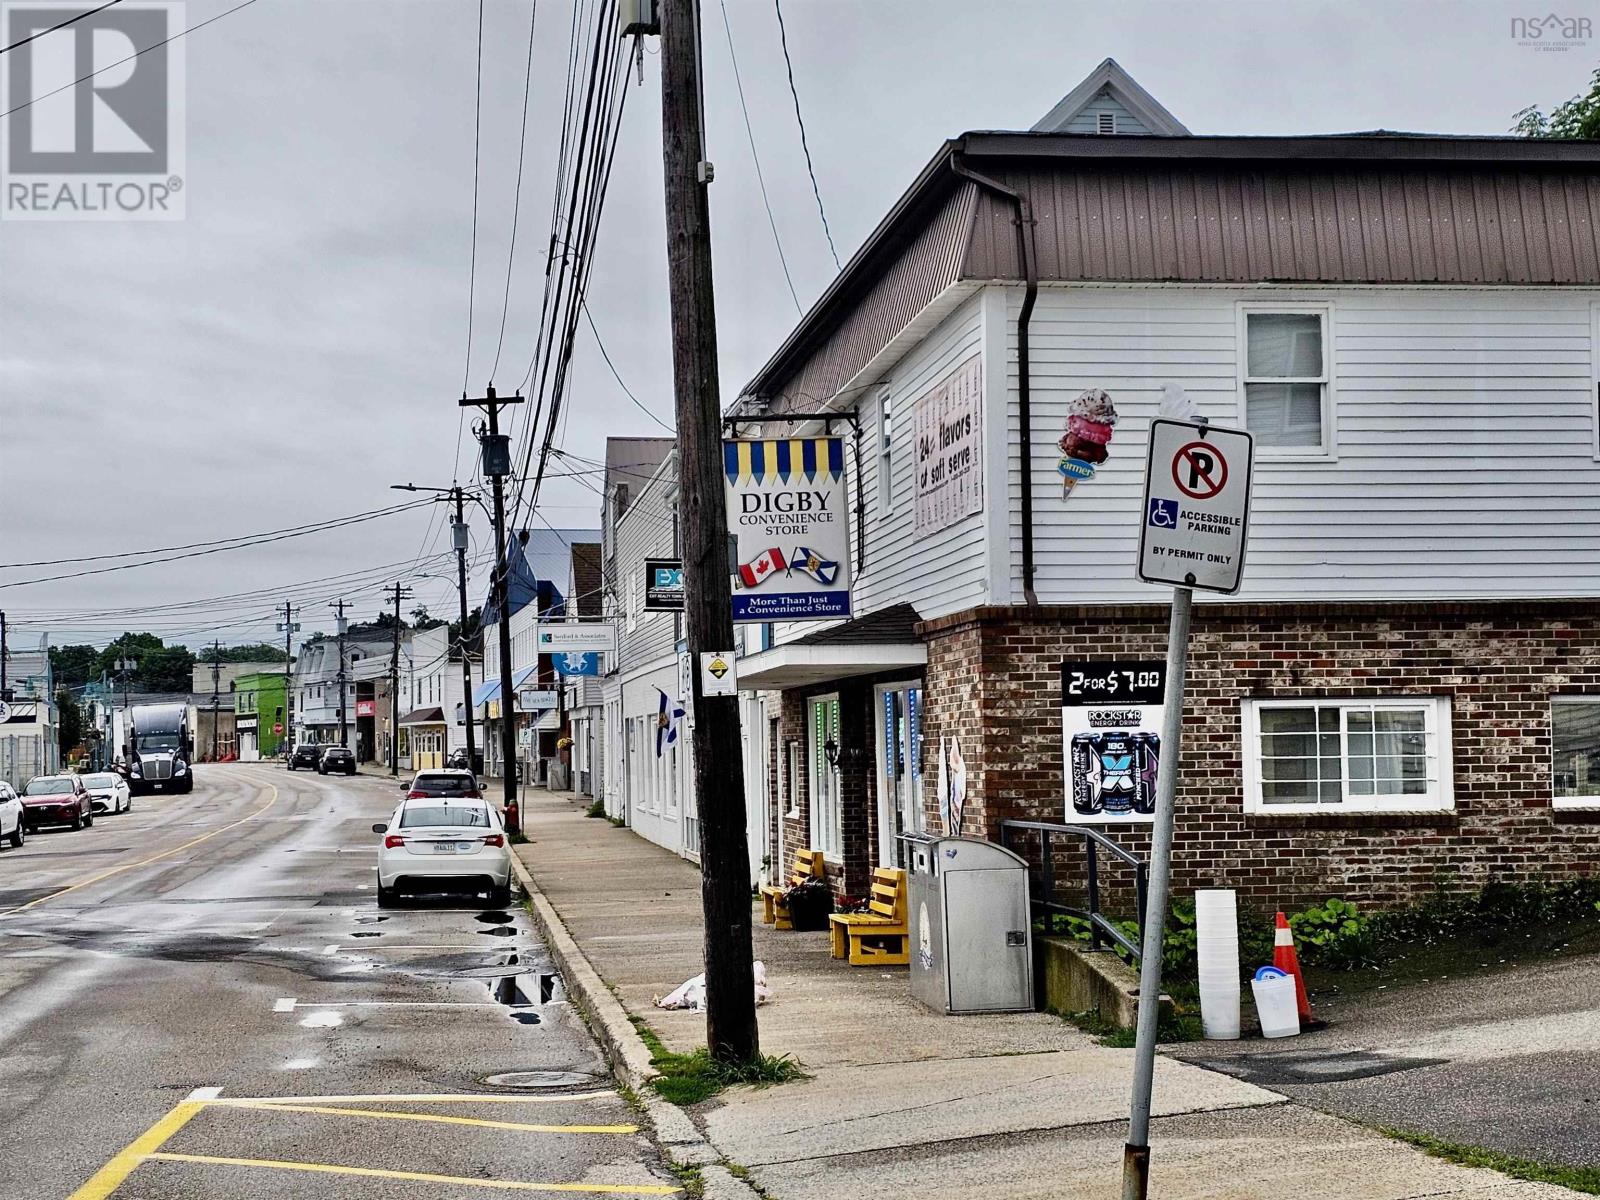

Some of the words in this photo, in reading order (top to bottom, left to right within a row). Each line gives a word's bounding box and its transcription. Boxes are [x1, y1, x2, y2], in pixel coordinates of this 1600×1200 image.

[939, 413, 971, 452] flavors
[921, 466, 928, 489] of
[931, 458, 945, 485] soft
[948, 446, 970, 475] serve
[740, 491, 831, 514] DIGBY
[739, 513, 833, 525] CONVENIENCE
[1180, 510, 1241, 526] ACCESSIBLE
[765, 525, 808, 535] STORE
[1188, 522, 1231, 535] PARKING
[1153, 546, 1165, 555] BY
[1168, 548, 1204, 560] PERMIT
[1207, 554, 1231, 565] ONLY
[748, 605, 812, 614] Convenience
[815, 603, 841, 611] Store
[750, 598, 777, 606] More
[778, 597, 805, 605] Than
[808, 596, 828, 605] Just
[1069, 672, 1084, 694] 2
[1084, 679, 1106, 689] FOR
